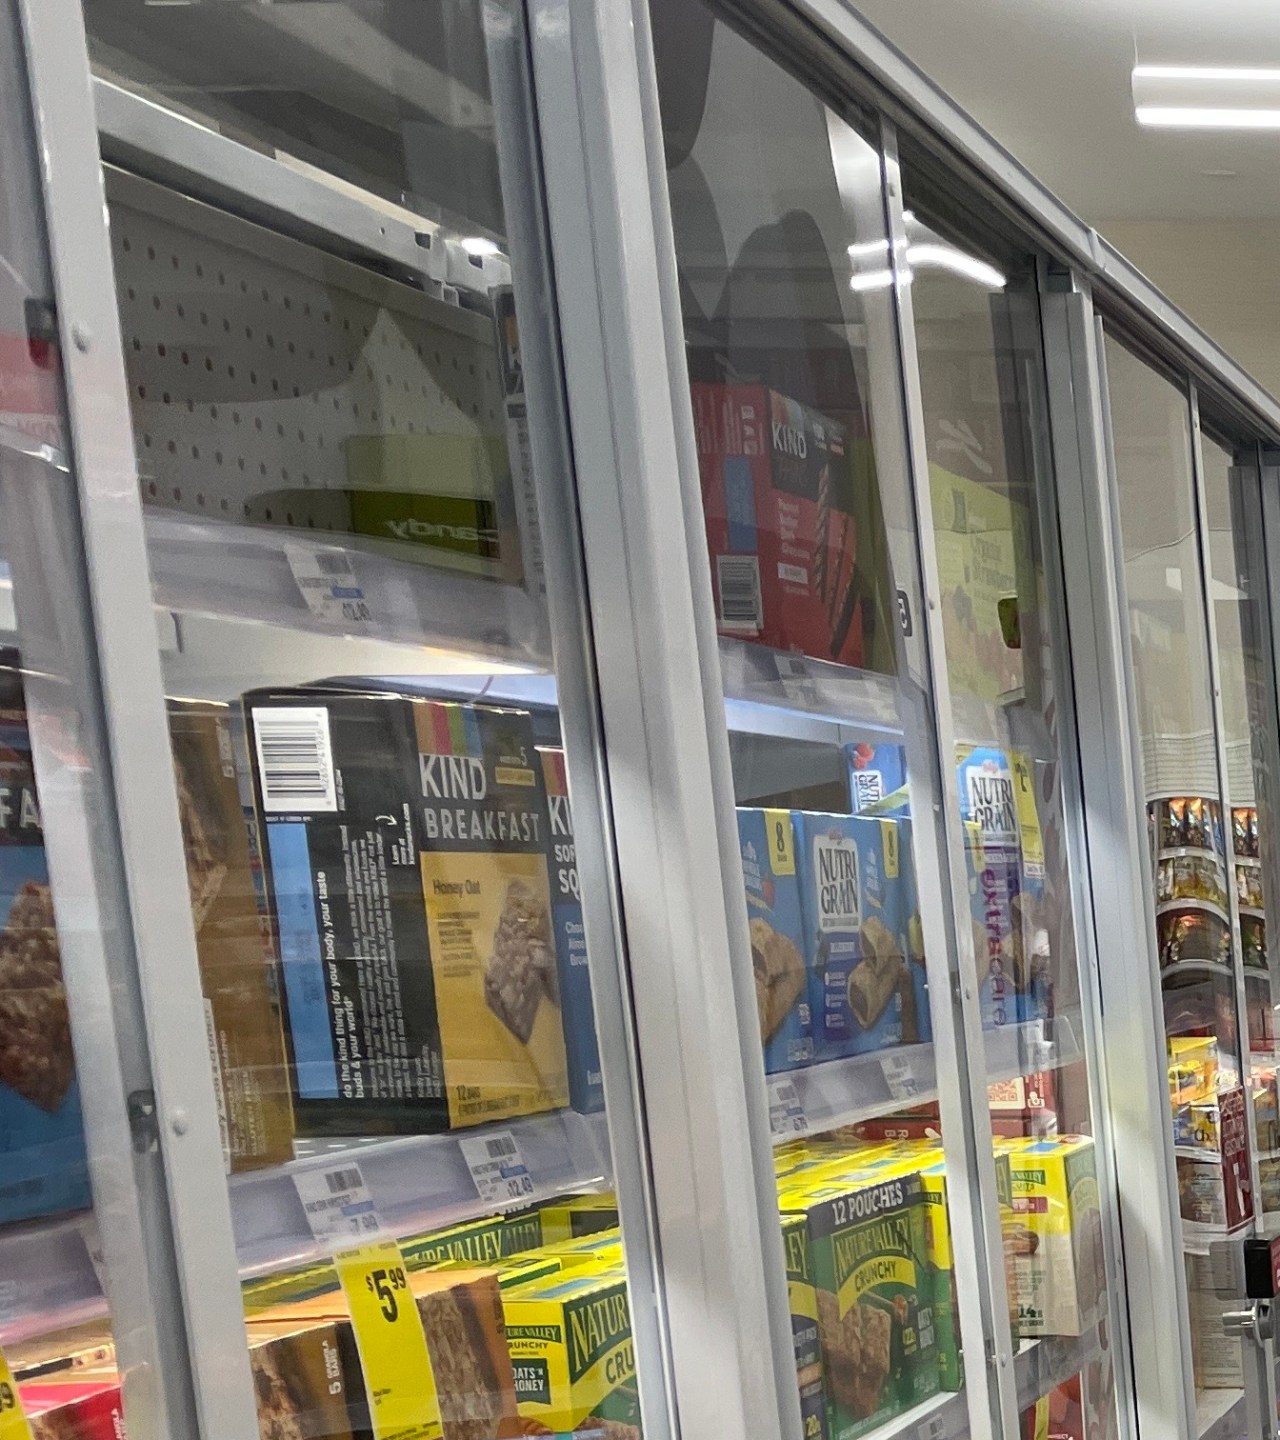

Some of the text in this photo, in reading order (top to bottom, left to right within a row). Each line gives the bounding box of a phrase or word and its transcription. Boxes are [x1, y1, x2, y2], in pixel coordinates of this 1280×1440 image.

[772, 423, 807, 459] KIND
[419, 752, 487, 801] KIND
[970, 776, 1013, 807] NUTRI
[423, 807, 540, 843] BREAKFAST
[973, 806, 1017, 833] GRAIN
[775, 821, 786, 854] 8
[818, 846, 858, 884] NUTRI
[433, 879, 482, 898] Honey Oat
[820, 881, 860, 916] GRAIN
[316, 871, 352, 1099] do the kind thing your body, your taste
[349, 1033, 365, 1099] buds your
[831, 1181, 904, 1227] 12 POUCHES
[854, 1259, 897, 1294] CRUNCHY
[526, 1325, 560, 1341] VALLEY
